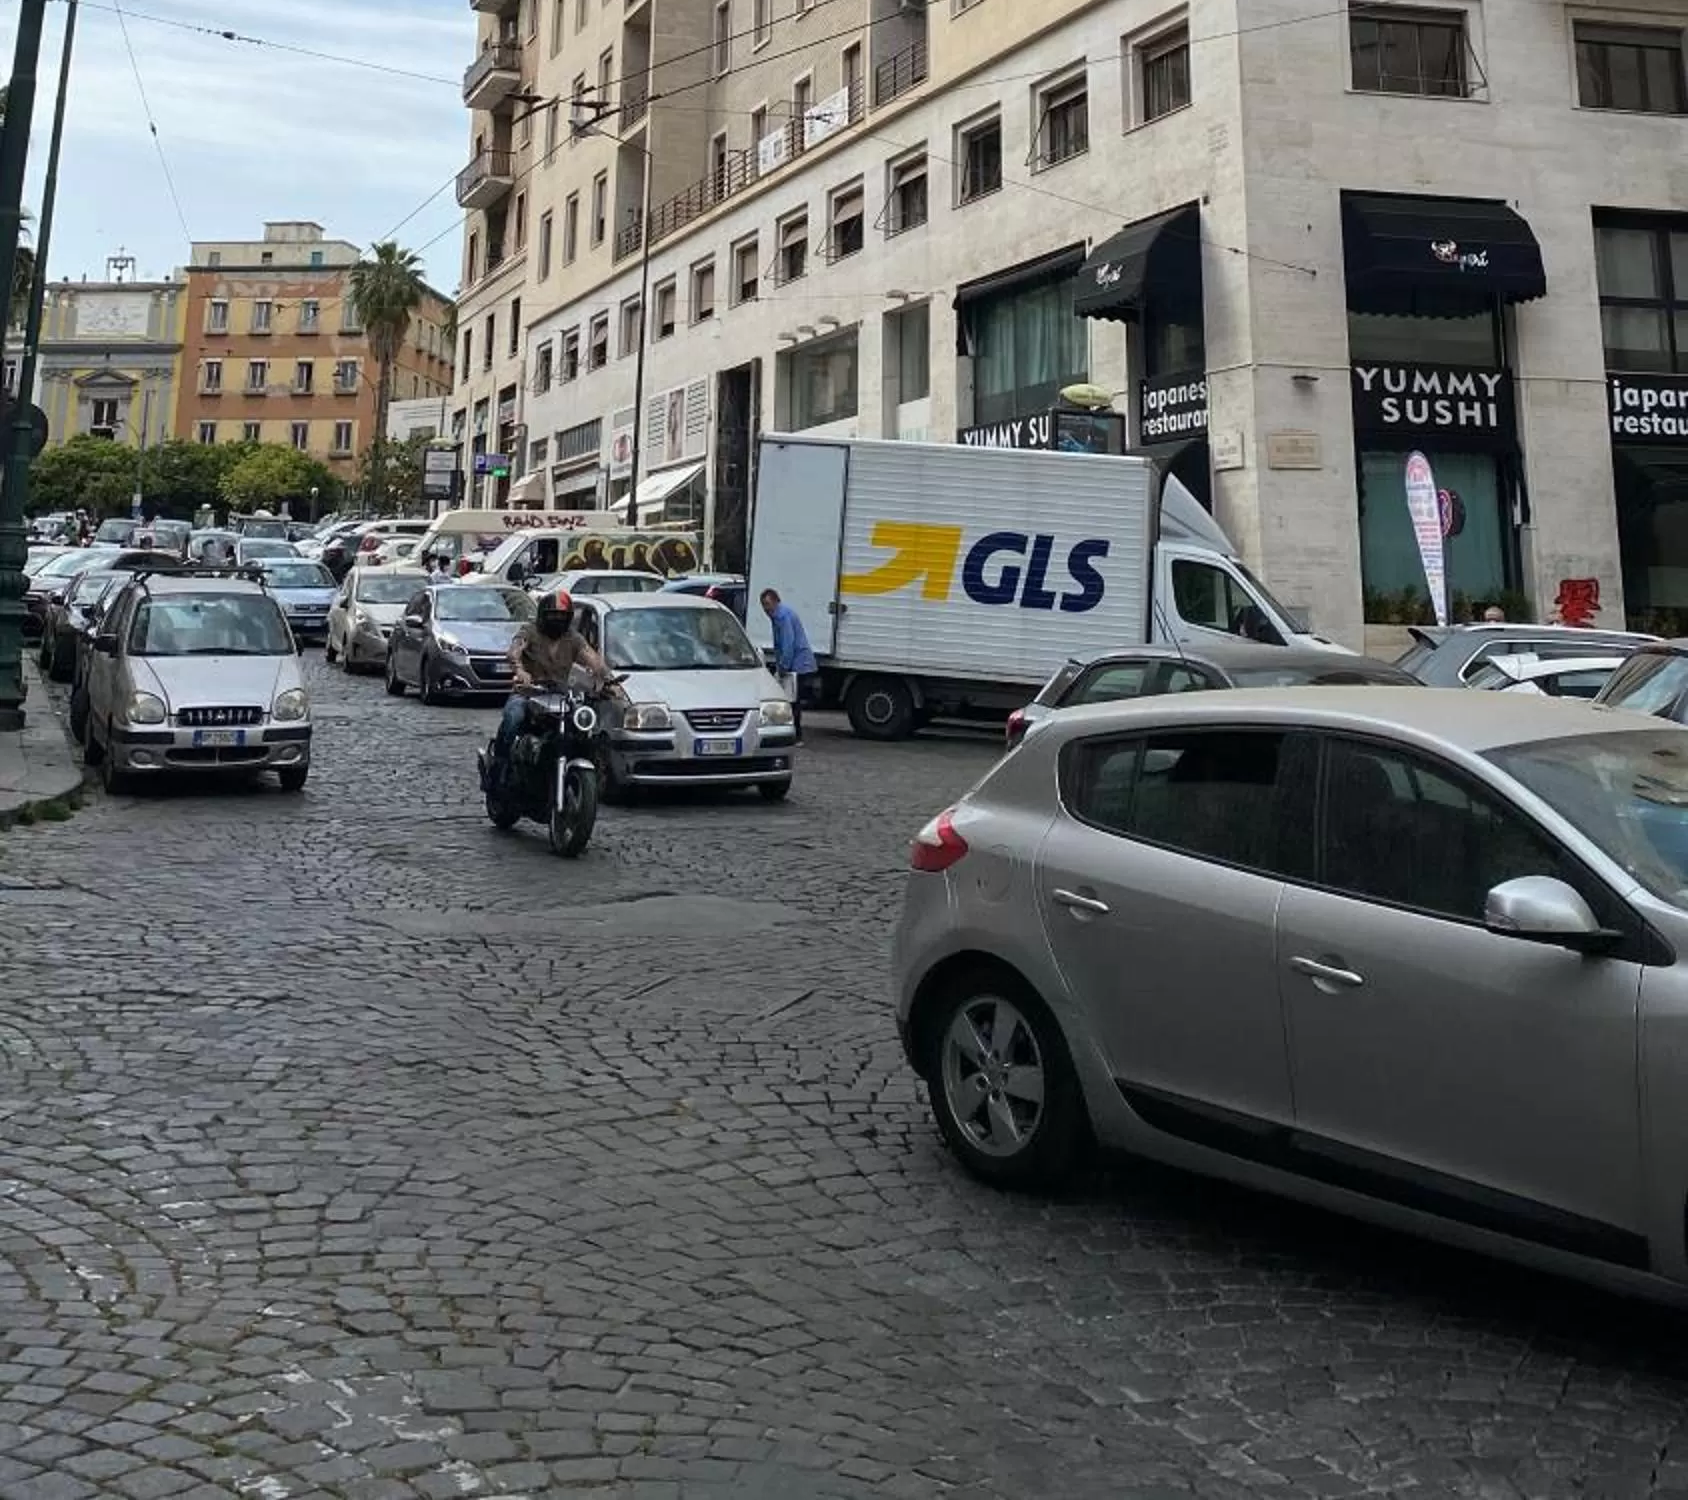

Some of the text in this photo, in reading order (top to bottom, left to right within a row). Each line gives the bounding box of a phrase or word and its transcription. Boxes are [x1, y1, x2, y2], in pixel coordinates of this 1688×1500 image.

[1355, 367, 1502, 397] YUMMY
[1381, 397, 1498, 427] SUSHI
[964, 421, 1022, 448] YUMMY
[962, 531, 1110, 613] GLS
